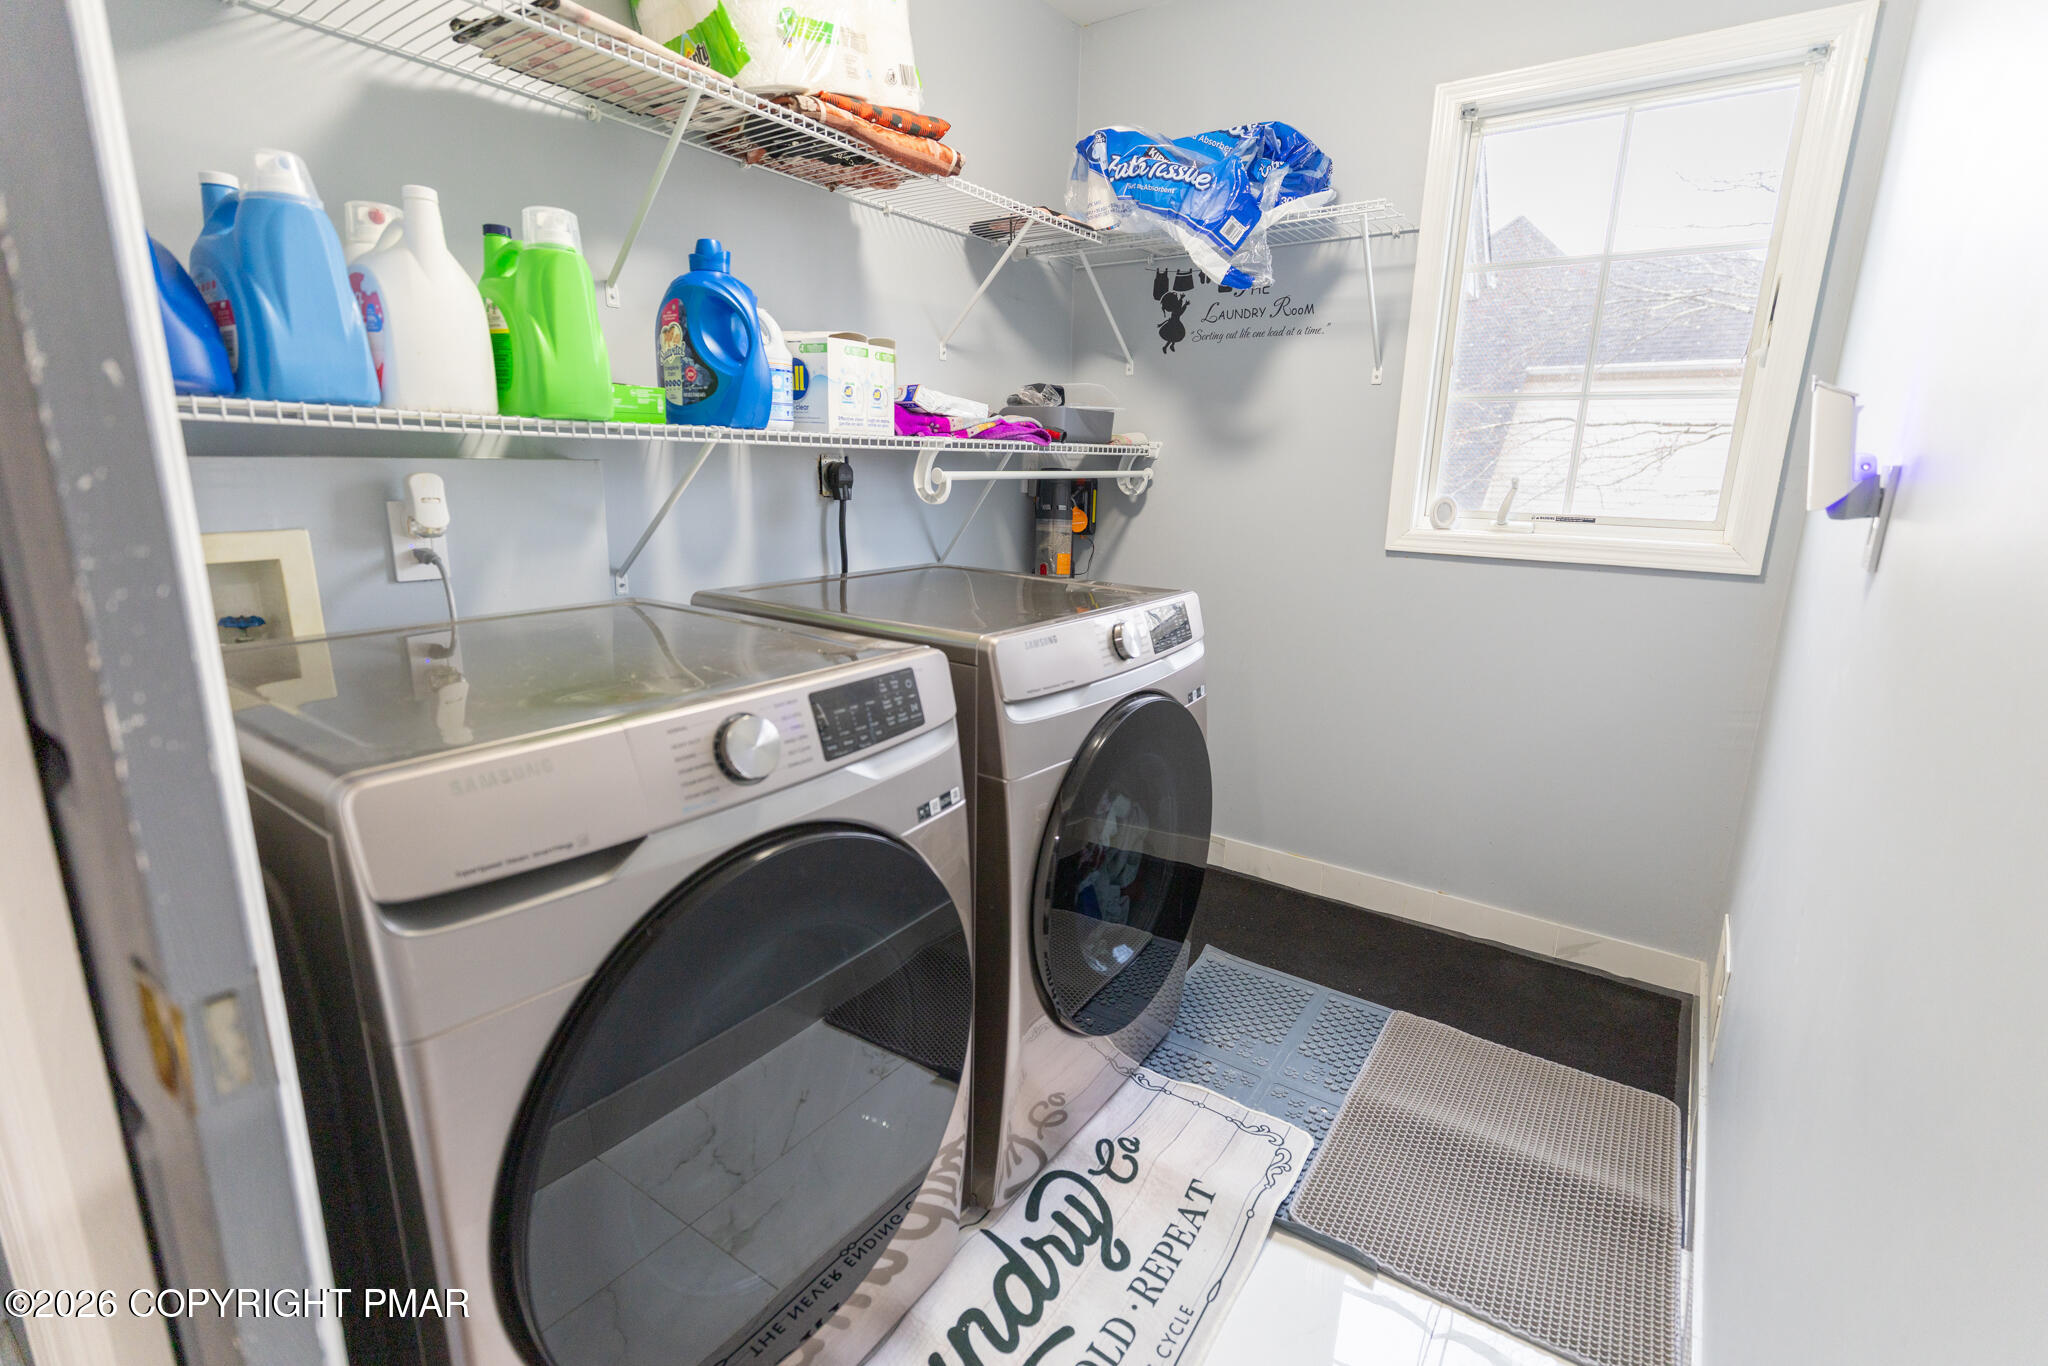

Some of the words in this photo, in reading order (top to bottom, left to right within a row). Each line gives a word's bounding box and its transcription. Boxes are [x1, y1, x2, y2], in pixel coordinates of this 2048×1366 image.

[1225, 330, 1238, 340] out
[1238, 326, 1251, 339] life
[1251, 330, 1266, 338] one
[1267, 325, 1284, 338] load
[1284, 326, 1296, 337] at
[1296, 328, 1302, 336] a
[793, 365, 805, 391] ll
[448, 757, 555, 796] SAMSUNG
[1088, 1135, 1141, 1184] Co
[1126, 1178, 1216, 1308] REPEAT
[1156, 1304, 1196, 1360] CYCLE
